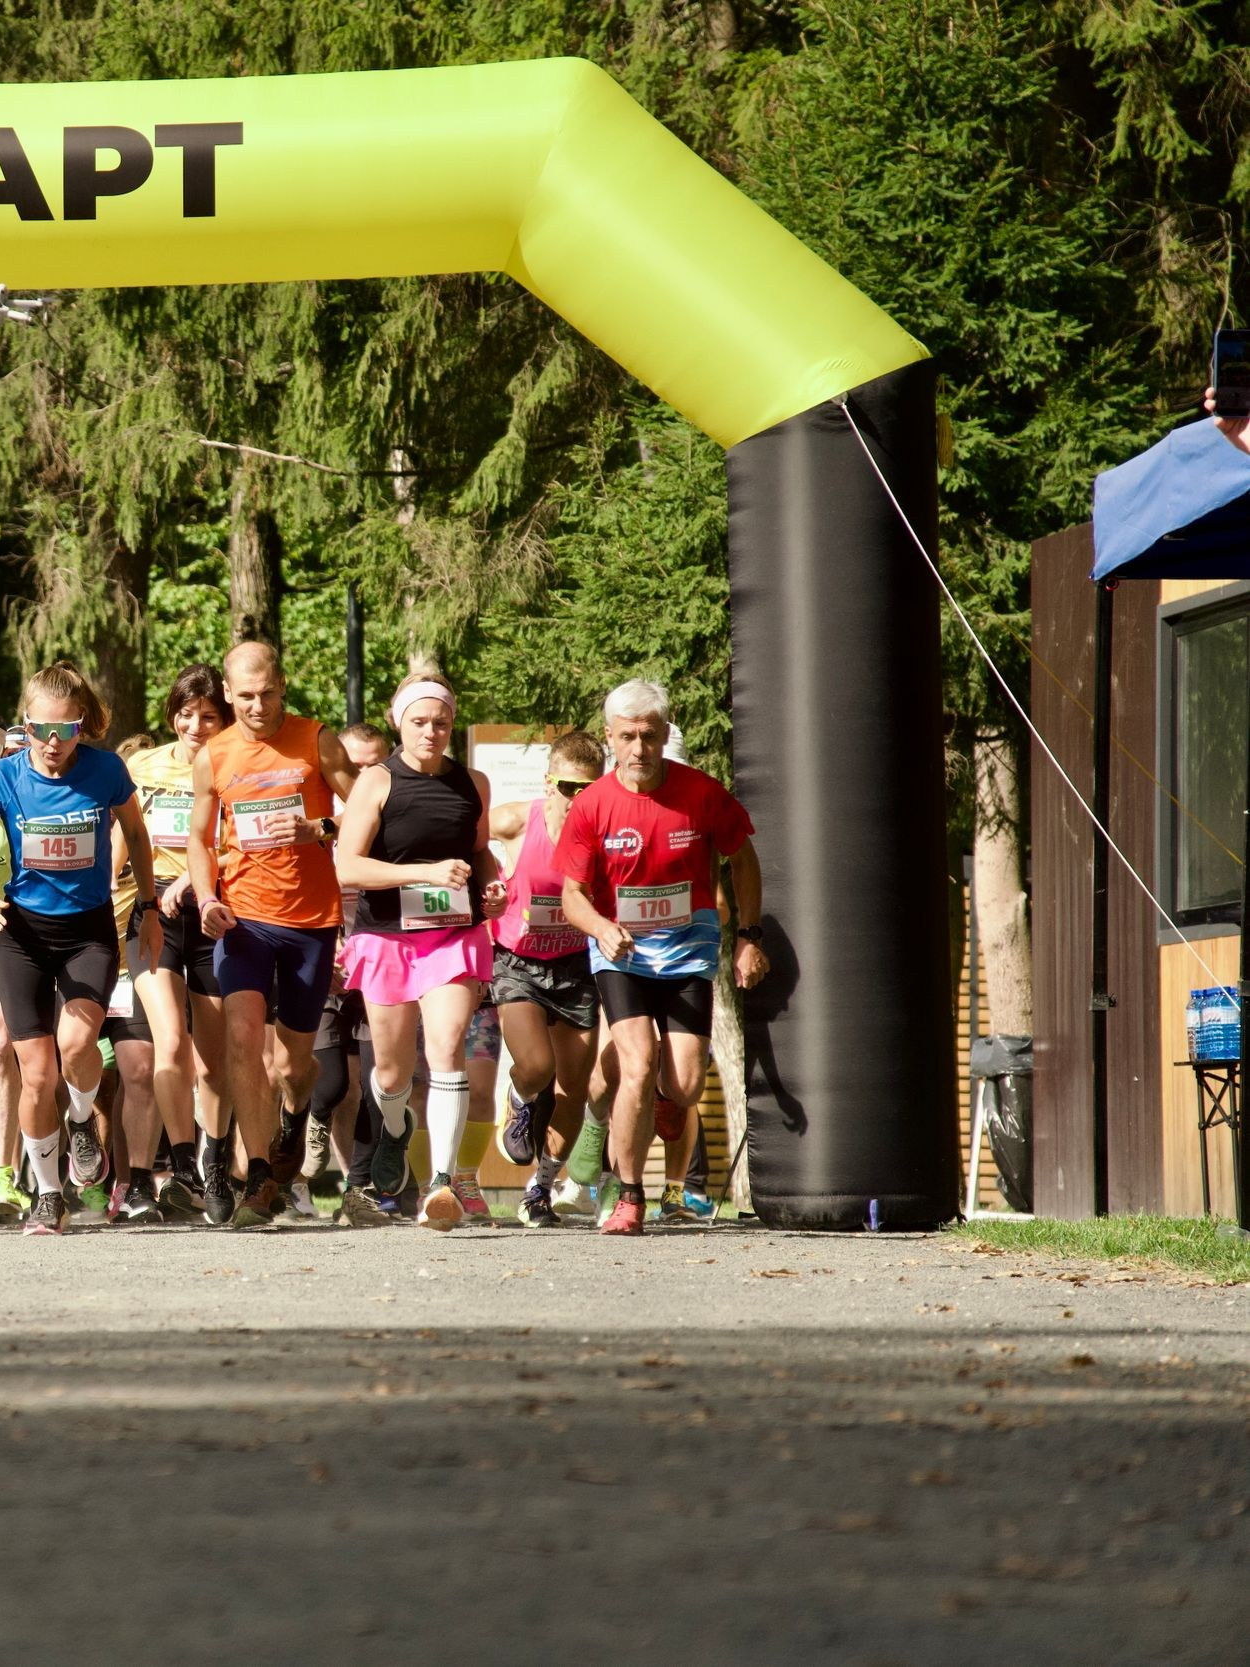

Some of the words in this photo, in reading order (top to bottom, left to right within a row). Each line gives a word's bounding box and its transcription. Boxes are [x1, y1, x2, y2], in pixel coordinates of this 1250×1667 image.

[240, 803, 268, 812] КРОСС
[269, 799, 296, 811] ДУБКИ
[60, 826, 88, 834] ДУБКИ
[41, 837, 78, 857] 145
[655, 886, 683, 896] ДУБКИ
[423, 890, 450, 913] 50
[637, 899, 672, 919] 170
